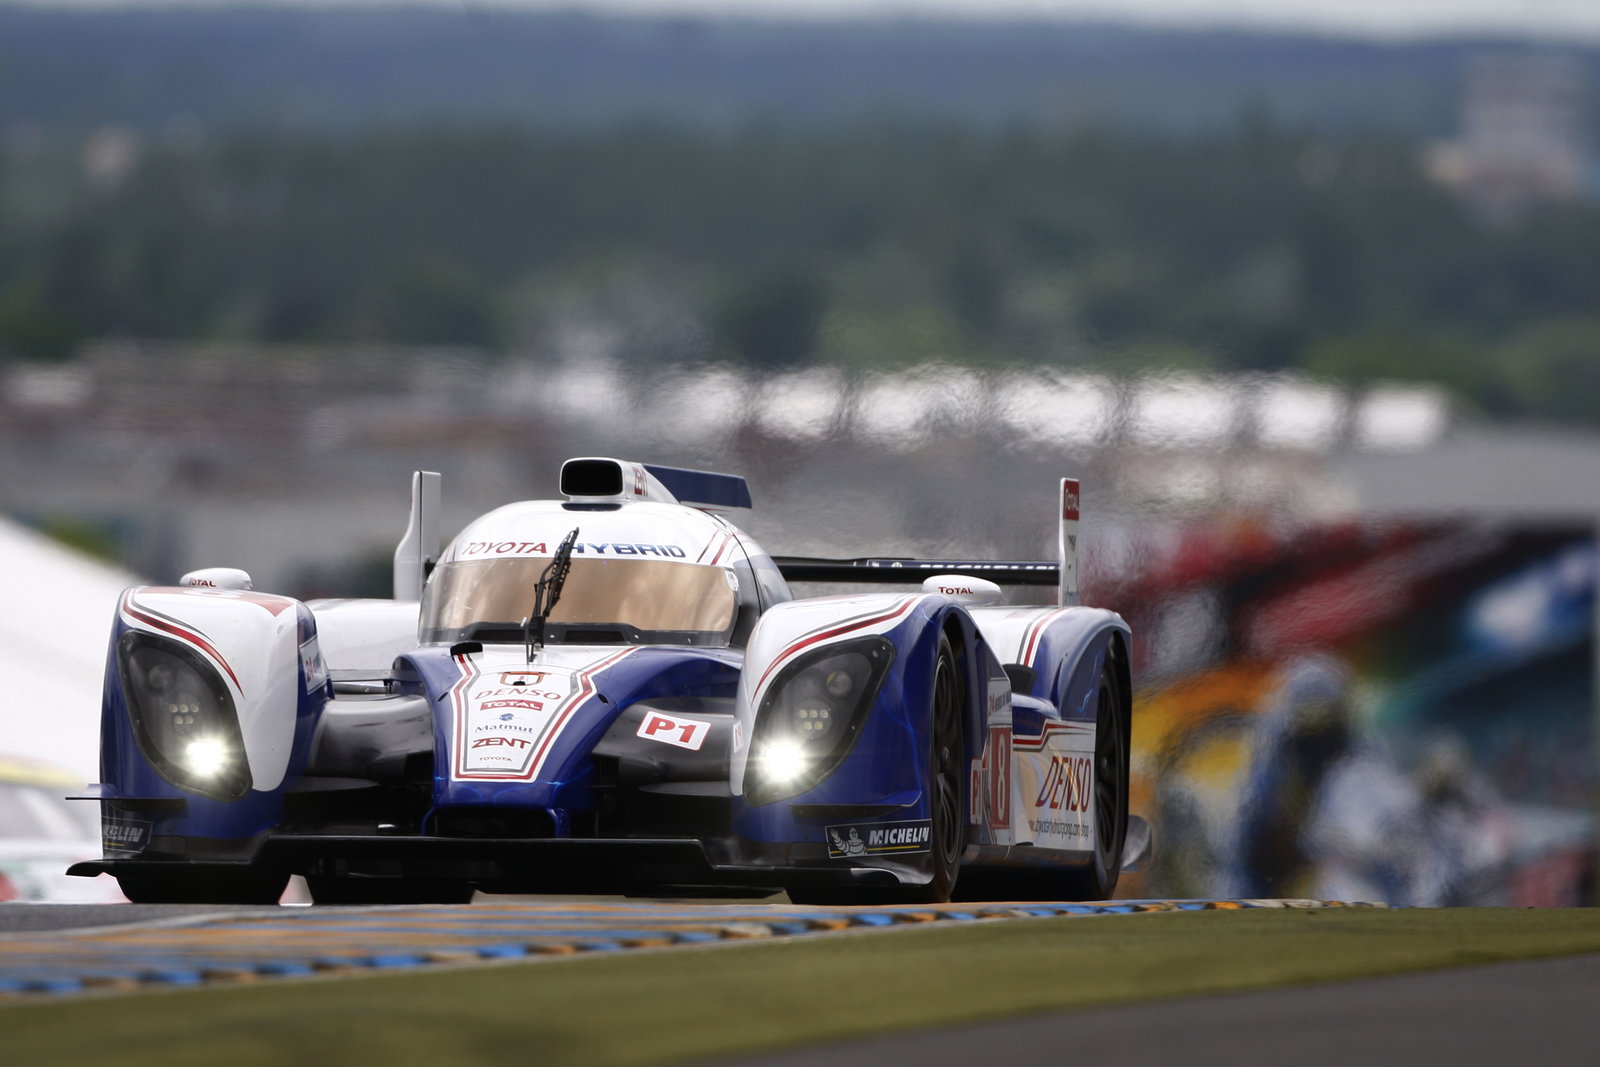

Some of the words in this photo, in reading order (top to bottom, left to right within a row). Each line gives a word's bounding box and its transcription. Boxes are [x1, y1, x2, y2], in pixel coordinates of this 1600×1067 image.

[461, 541, 548, 556] TOYOTA
[188, 577, 217, 588] TOTAL
[938, 586, 974, 595] TOTAL
[474, 687, 562, 700] DENSO
[483, 701, 542, 710] TOTAL
[474, 723, 534, 734] Matmut
[645, 716, 697, 744] P1
[471, 737, 532, 750] ZENT
[1035, 755, 1092, 813] DENSO
[868, 826, 931, 846] MICHELIN
